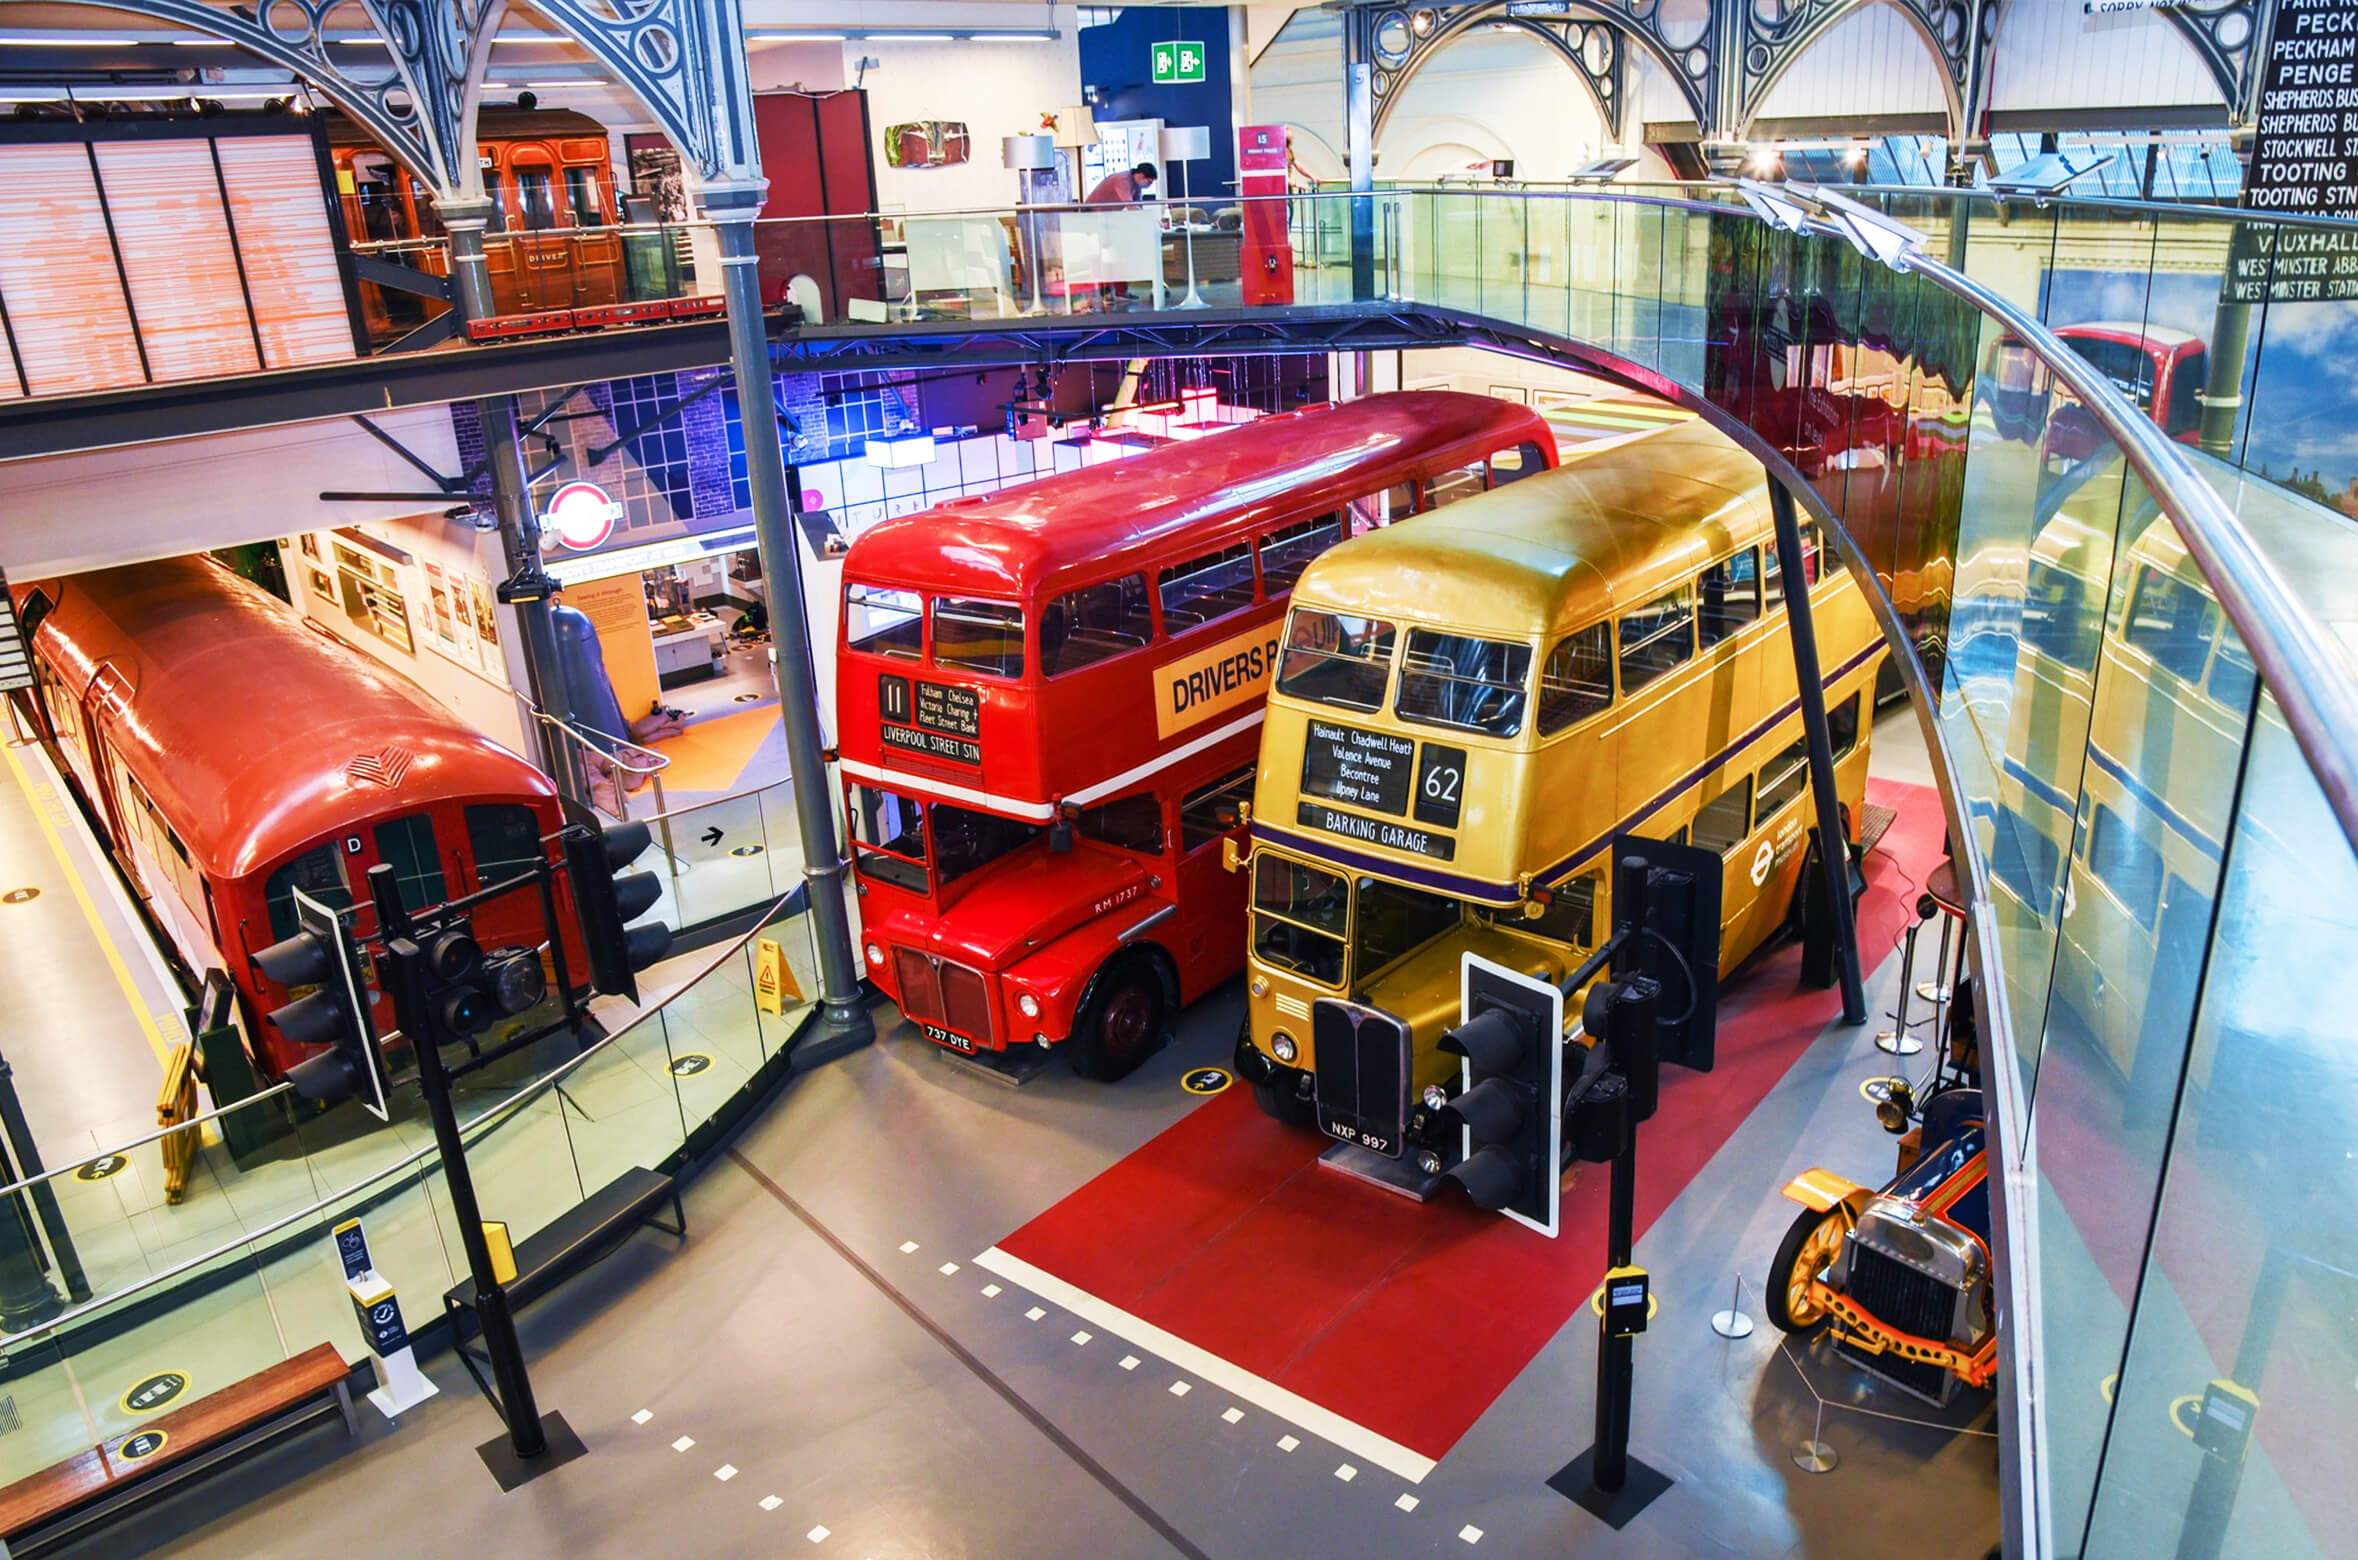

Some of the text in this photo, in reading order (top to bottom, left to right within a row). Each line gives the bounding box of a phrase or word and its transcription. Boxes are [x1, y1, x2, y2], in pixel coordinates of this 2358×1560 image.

[2296, 12, 2358, 34] PECK
[2273, 37, 2356, 60] PECKHAM
[2279, 63, 2354, 85] PENGE
[2264, 88, 2335, 110] SHEPHERDS
[2260, 113, 2338, 135] SHEPHERDS
[2262, 137, 2358, 159] STOCKWELL ST
[2260, 162, 2347, 183] TOOTING
[2250, 185, 2358, 207] TOOTING STN
[2333, 256, 2358, 275] ABB
[1173, 646, 1263, 714] DRIVERS
[888, 684, 901, 713] 11
[921, 683, 974, 706] Fulham Chelsea
[920, 697, 943, 713] Victoria
[947, 703, 970, 722] Charing
[920, 710, 977, 734] Fleet Street Bank
[884, 726, 980, 760] LIVERPOOL STREET STN
[1314, 724, 1345, 742] Hainault
[1351, 730, 1388, 751] Chadwell
[1332, 745, 1392, 770] Valence Avenue
[1340, 763, 1380, 785] Becontree
[1425, 766, 1459, 801] 62
[1336, 781, 1380, 803] Upney Lane
[1326, 812, 1428, 853] BARKING GARAGE
[347, 838, 361, 852] D
[1115, 886, 1137, 904] 1737
[927, 1025, 970, 1051] 737 DYE
[1332, 1121, 1388, 1150] NXP 997
